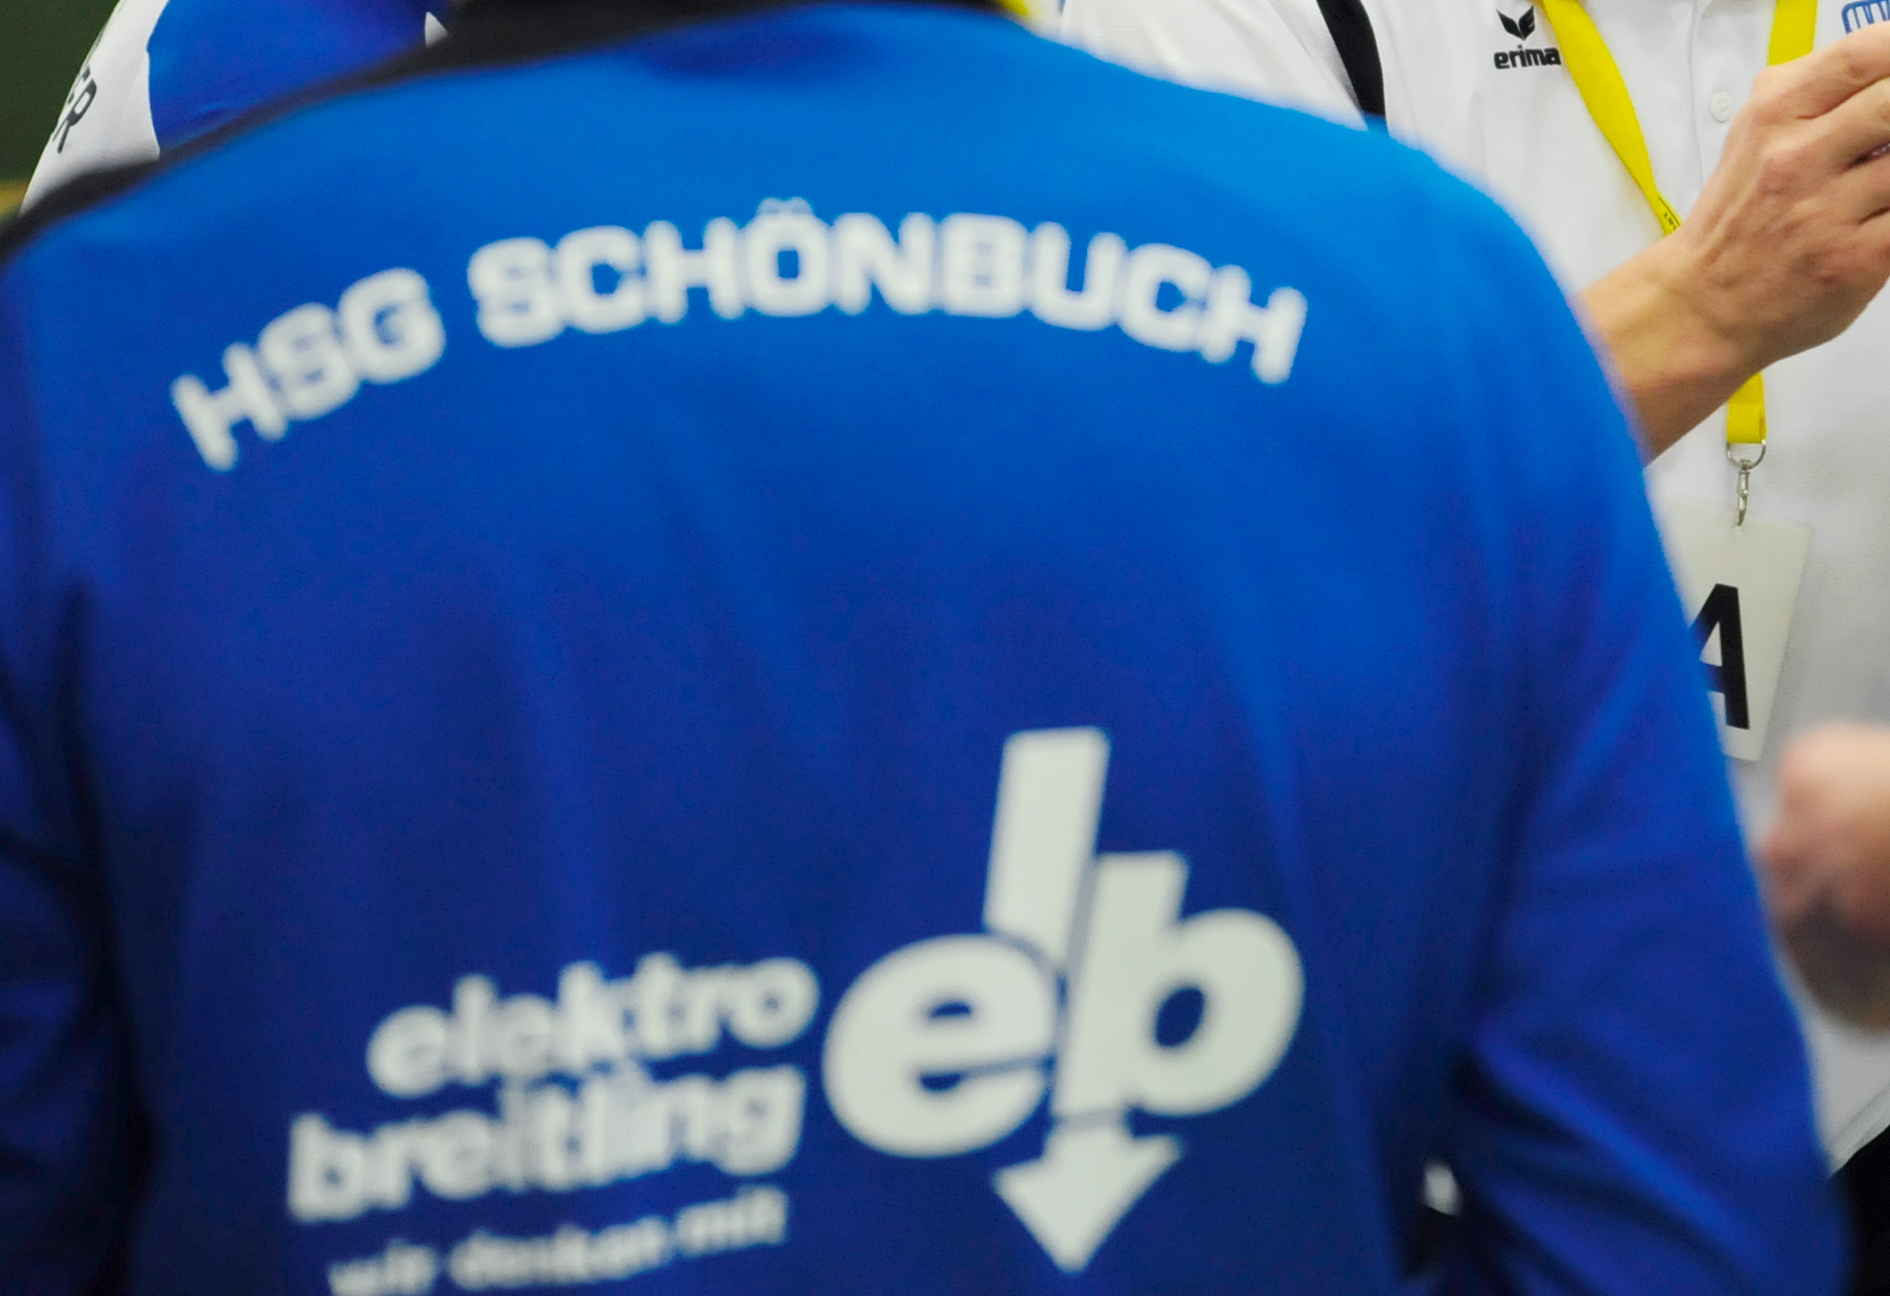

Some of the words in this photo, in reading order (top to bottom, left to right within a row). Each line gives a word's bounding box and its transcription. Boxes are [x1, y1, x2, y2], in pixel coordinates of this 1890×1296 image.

[1493, 44, 1562, 70] erima
[172, 266, 446, 470] HSG
[465, 197, 1308, 385] SCHÖNBUCH
[1688, 583, 1751, 730] A
[366, 952, 820, 1098] elektro
[288, 1062, 805, 1221] breitling
